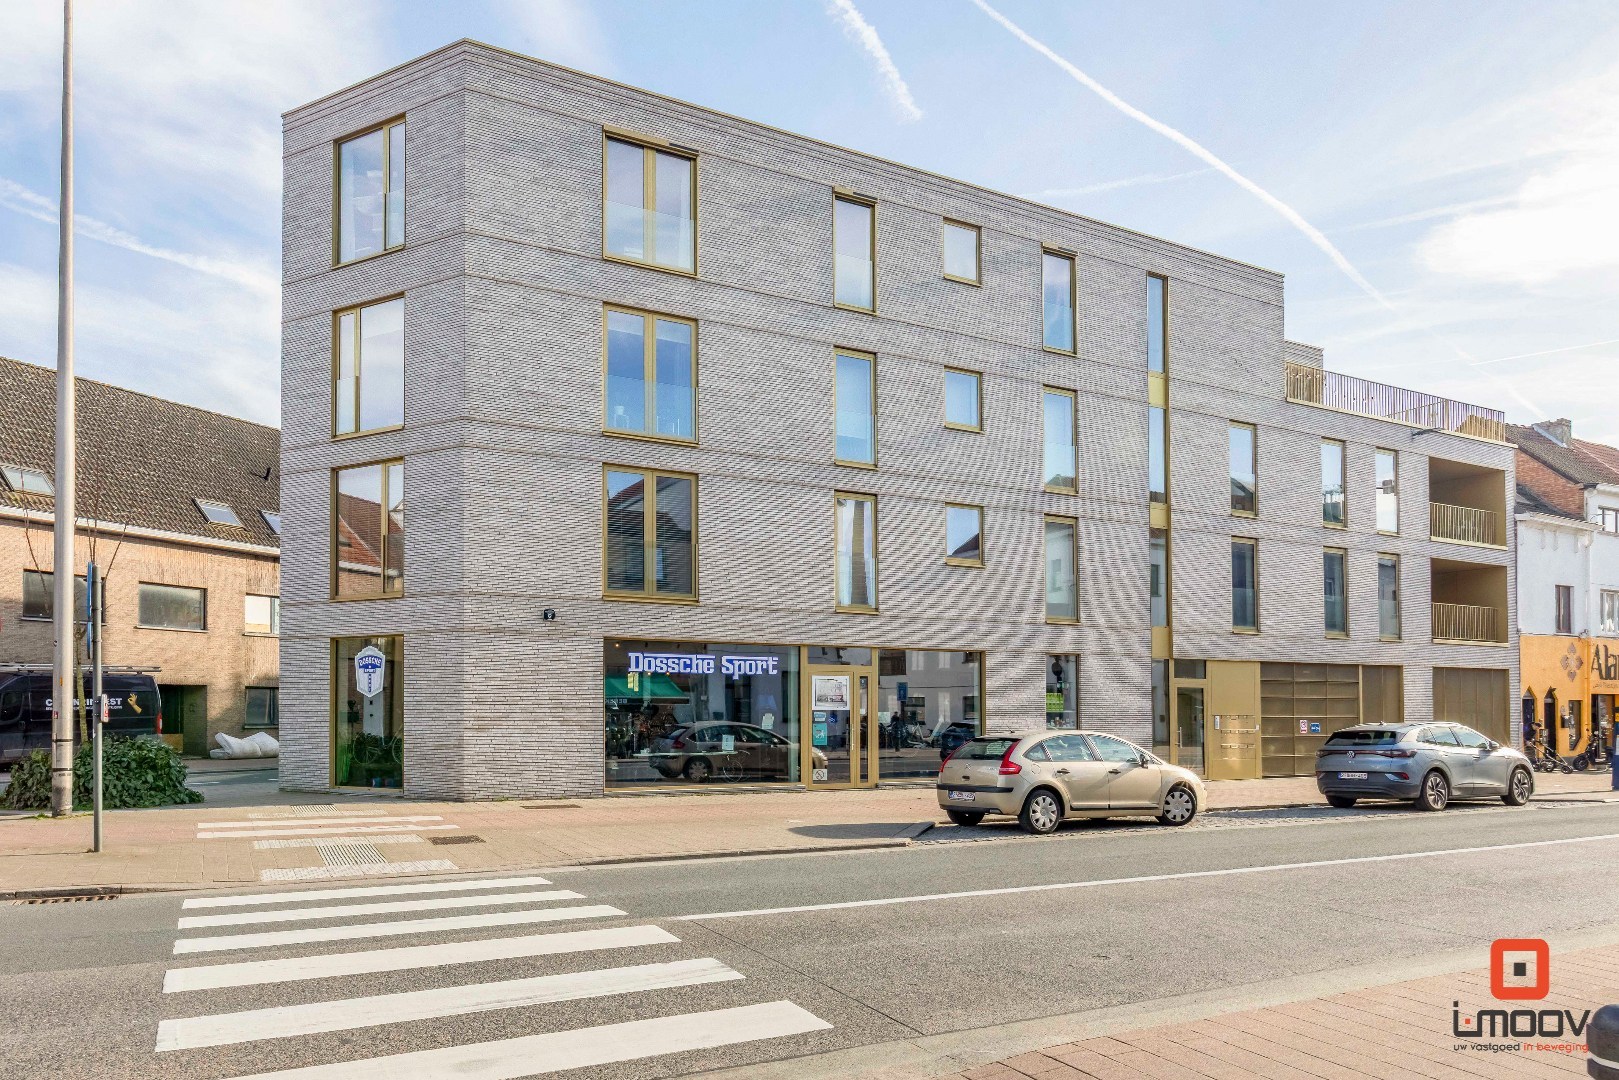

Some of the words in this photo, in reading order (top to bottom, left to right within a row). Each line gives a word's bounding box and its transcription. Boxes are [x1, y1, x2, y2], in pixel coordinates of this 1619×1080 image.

[628, 652, 716, 674] Dossche
[721, 655, 779, 680] Sport
[1591, 644, 1619, 680] Ala
